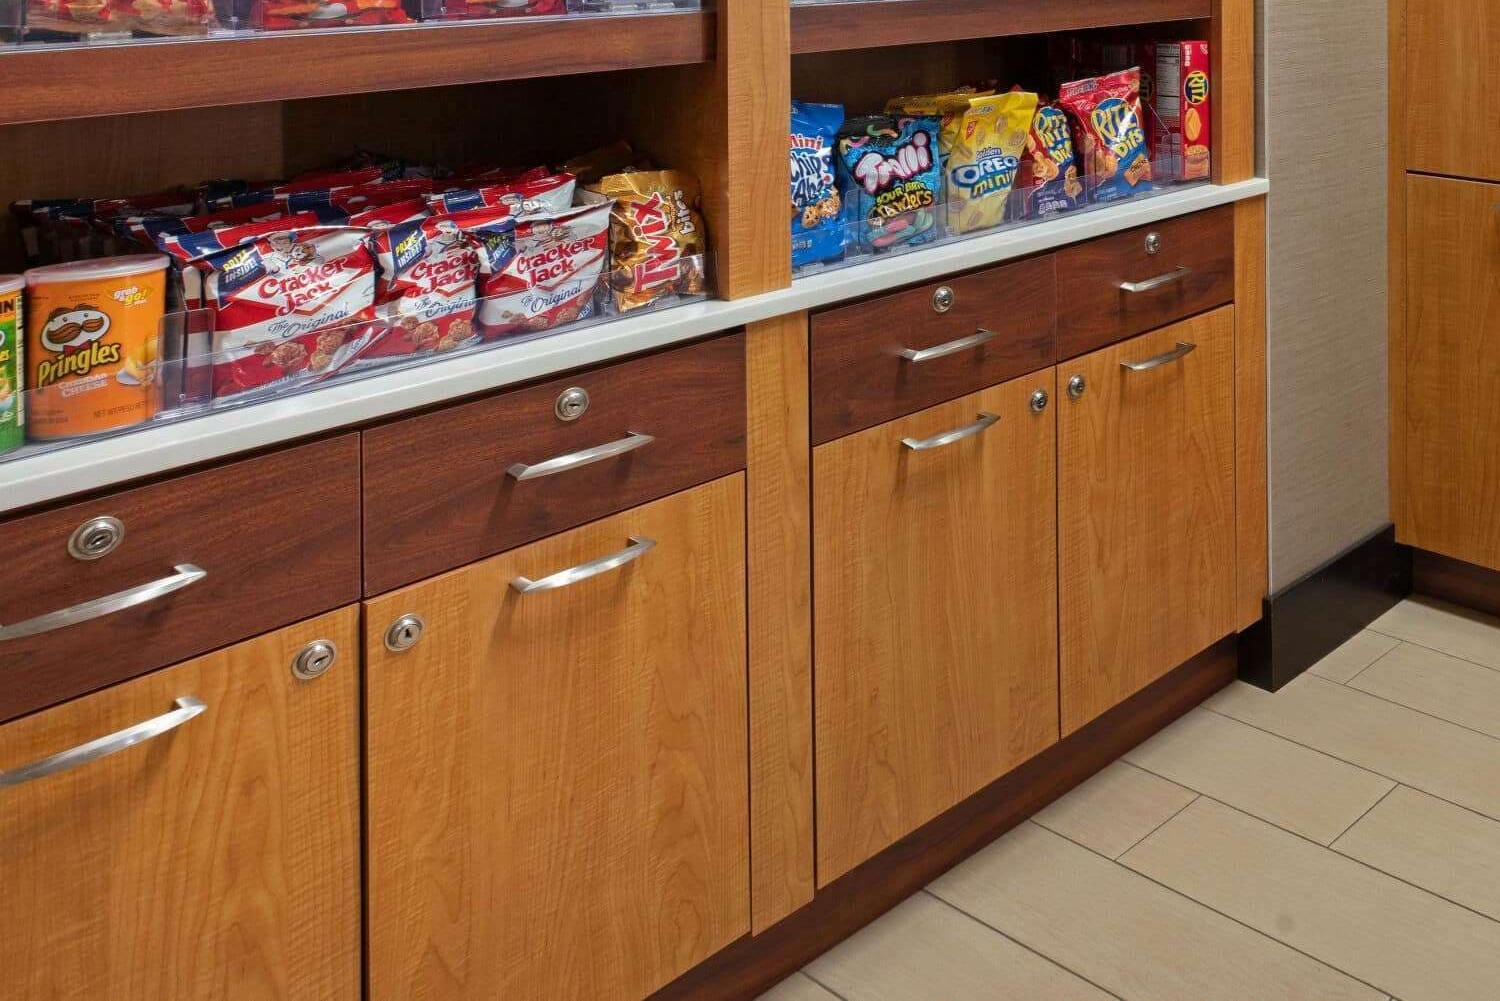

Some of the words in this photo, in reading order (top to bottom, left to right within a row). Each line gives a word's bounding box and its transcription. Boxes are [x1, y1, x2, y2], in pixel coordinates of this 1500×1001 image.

[1187, 72, 1207, 104] RITZ
[1091, 100, 1140, 150] RITZ
[854, 131, 932, 195] Trolli
[951, 156, 1018, 188] OREO
[875, 185, 904, 207] SOUR
[410, 251, 477, 281] Crack
[516, 237, 595, 275] Cracker
[527, 257, 575, 289] Jack
[257, 256, 348, 299] Cracker
[423, 265, 480, 295] Jack
[275, 279, 334, 317] Jack
[425, 297, 476, 318] Origina
[530, 279, 583, 313] Original
[267, 319, 288, 334] The
[281, 301, 350, 339] Original
[37, 342, 121, 392] Pringles
